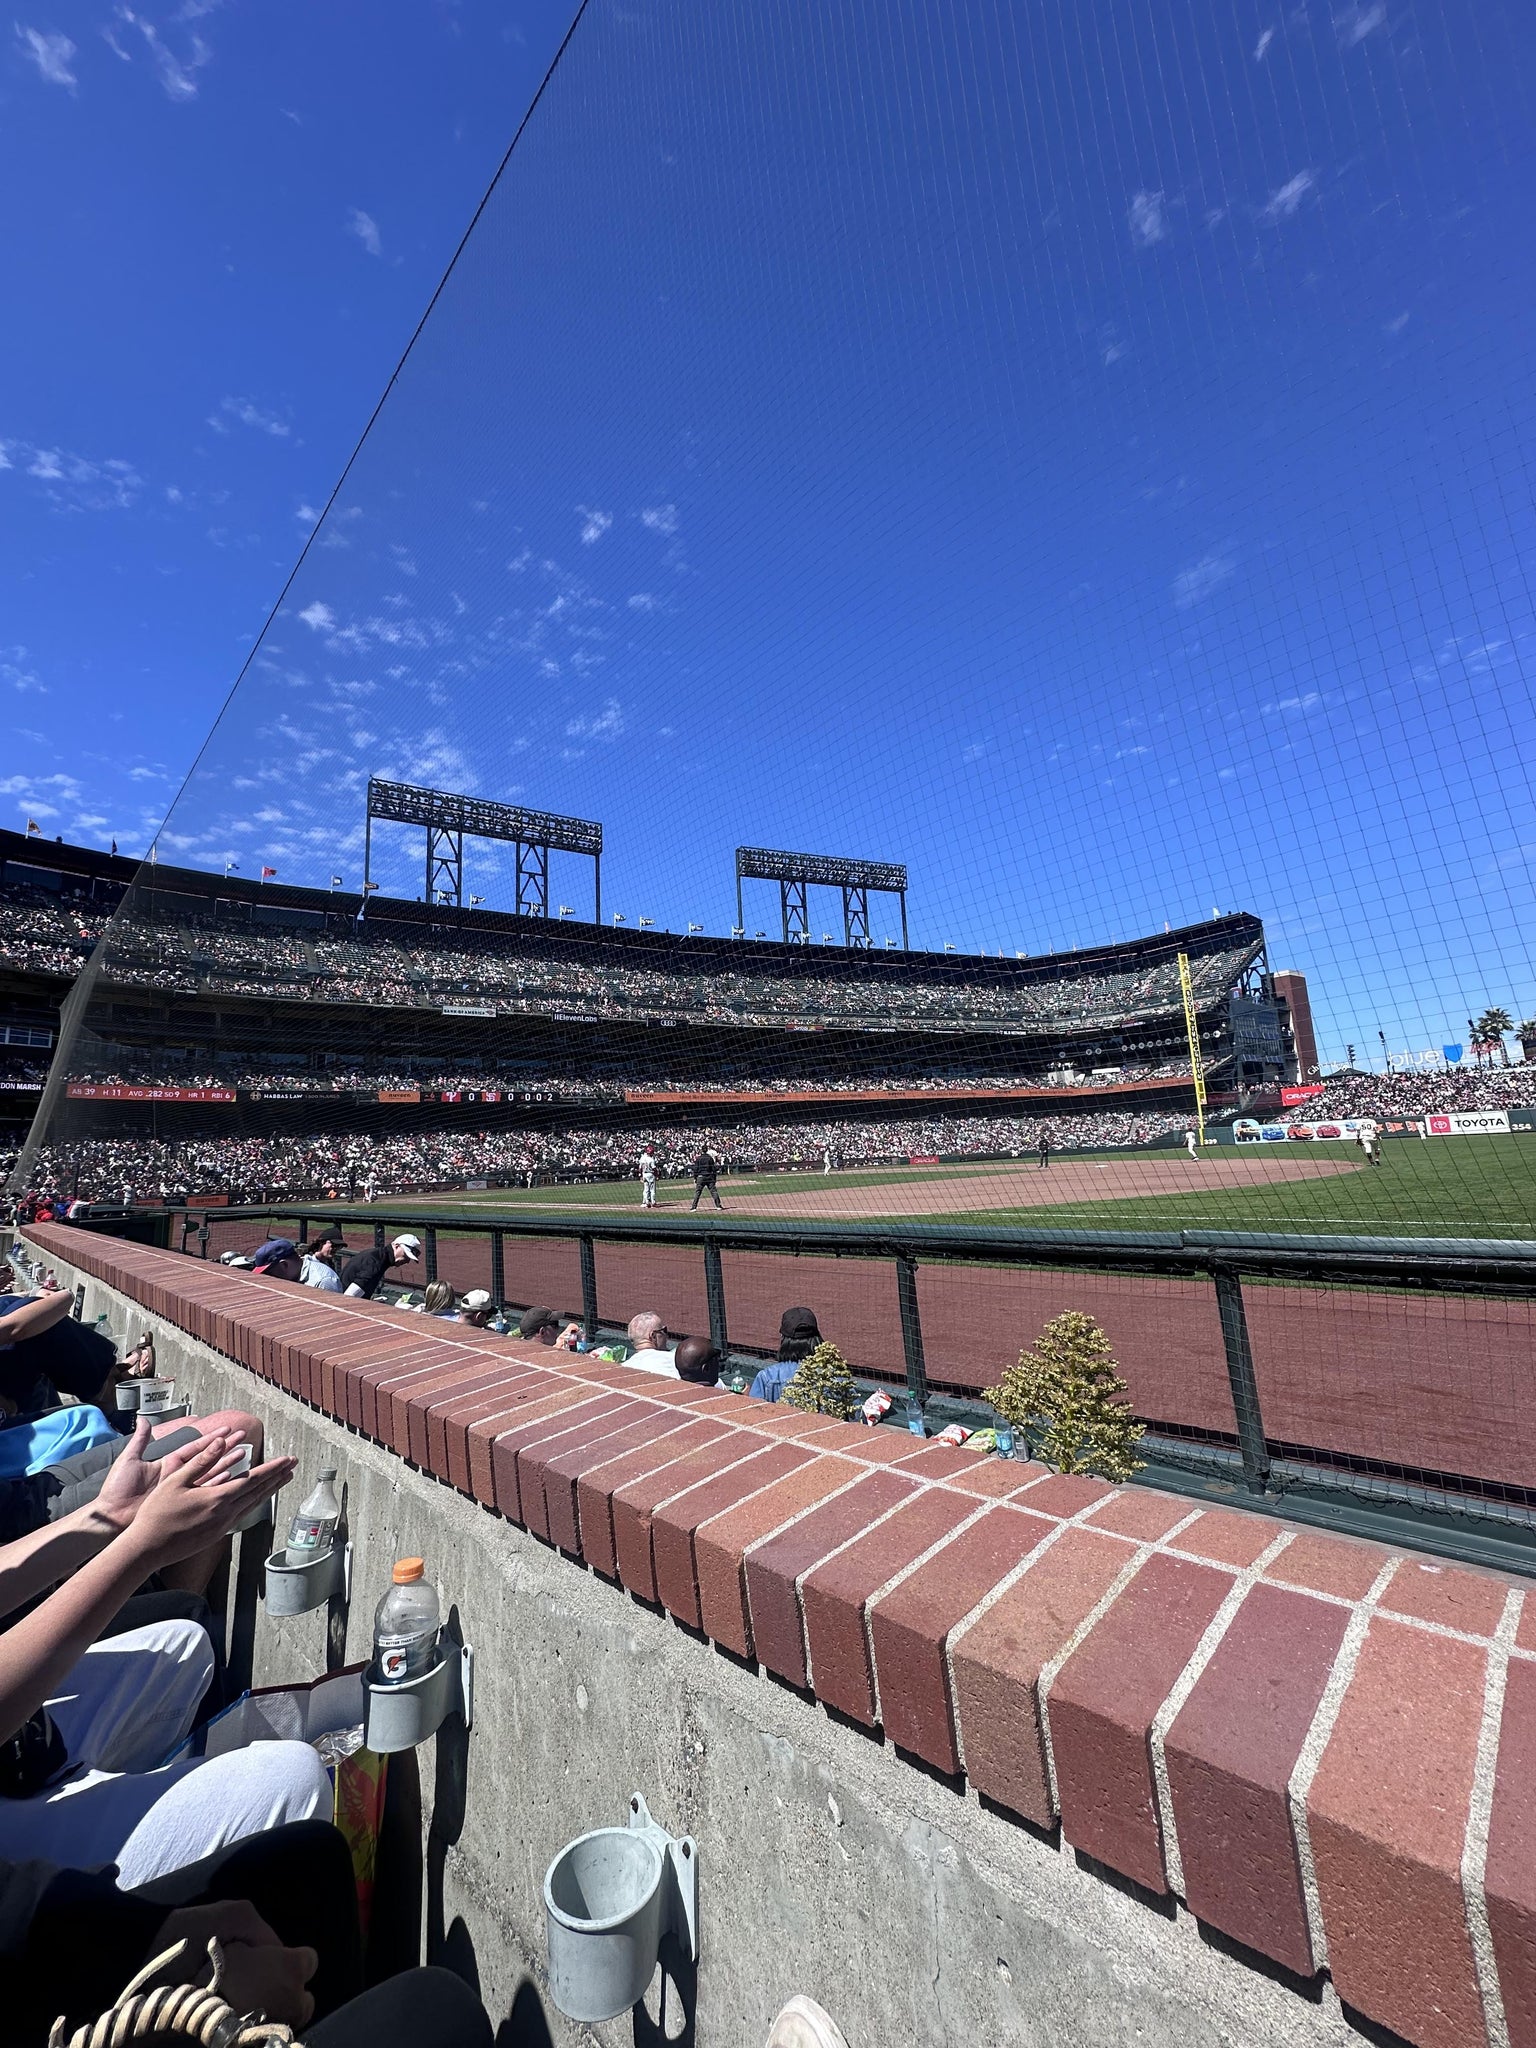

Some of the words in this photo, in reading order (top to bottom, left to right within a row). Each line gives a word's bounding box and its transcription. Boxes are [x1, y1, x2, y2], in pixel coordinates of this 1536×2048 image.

[1388, 1049, 1440, 1067] blue
[85, 1088, 96, 1096] 39
[468, 1093, 475, 1101] 0
[508, 1093, 514, 1101] 0
[525, 1093, 531, 1101] 0
[536, 1093, 542, 1101] 0
[547, 1093, 553, 1101] 2
[1455, 1118, 1505, 1128] TOYOTA
[381, 1647, 407, 1679] G
